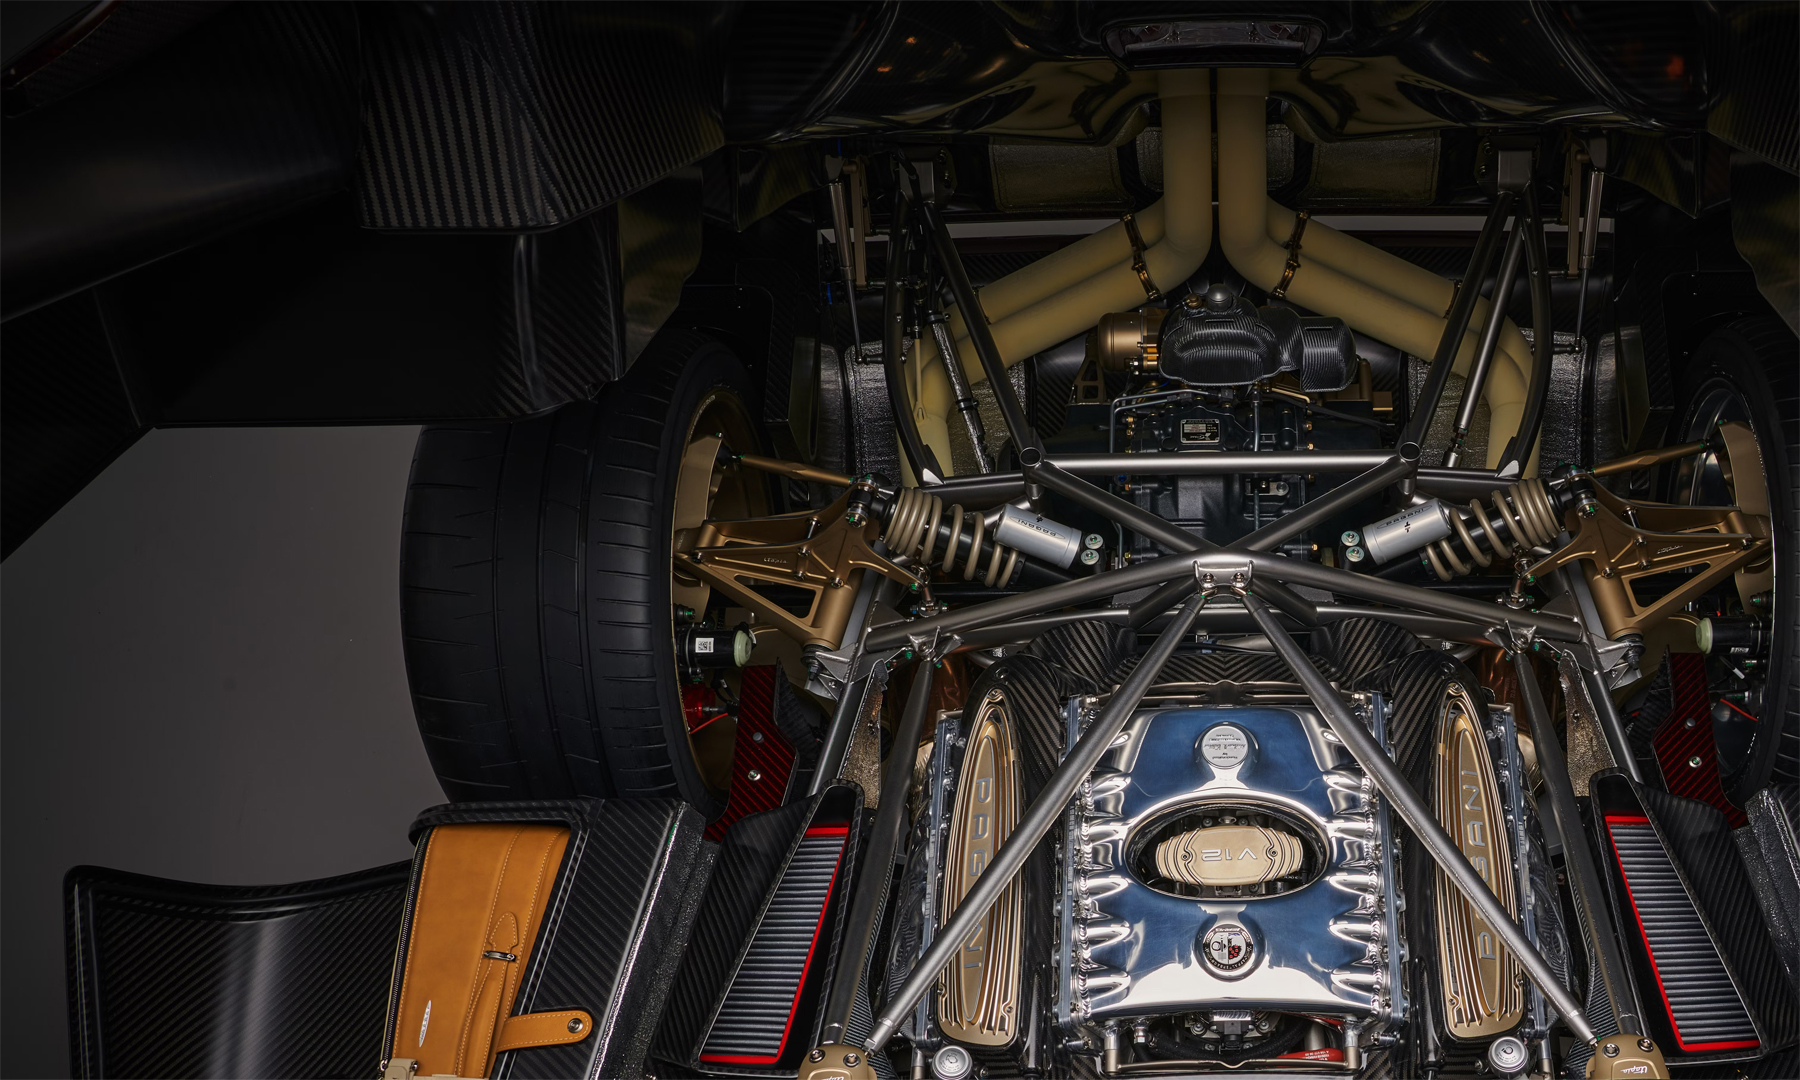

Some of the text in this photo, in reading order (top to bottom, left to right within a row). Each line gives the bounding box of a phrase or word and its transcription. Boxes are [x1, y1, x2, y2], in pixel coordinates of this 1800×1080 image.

[1386, 508, 1424, 526] PAGANI
[1017, 519, 1057, 537] PAGANI
[964, 777, 992, 969] PAGNI
[1462, 770, 1496, 960] PGANI
[1620, 1065, 1648, 1074] Utopia
